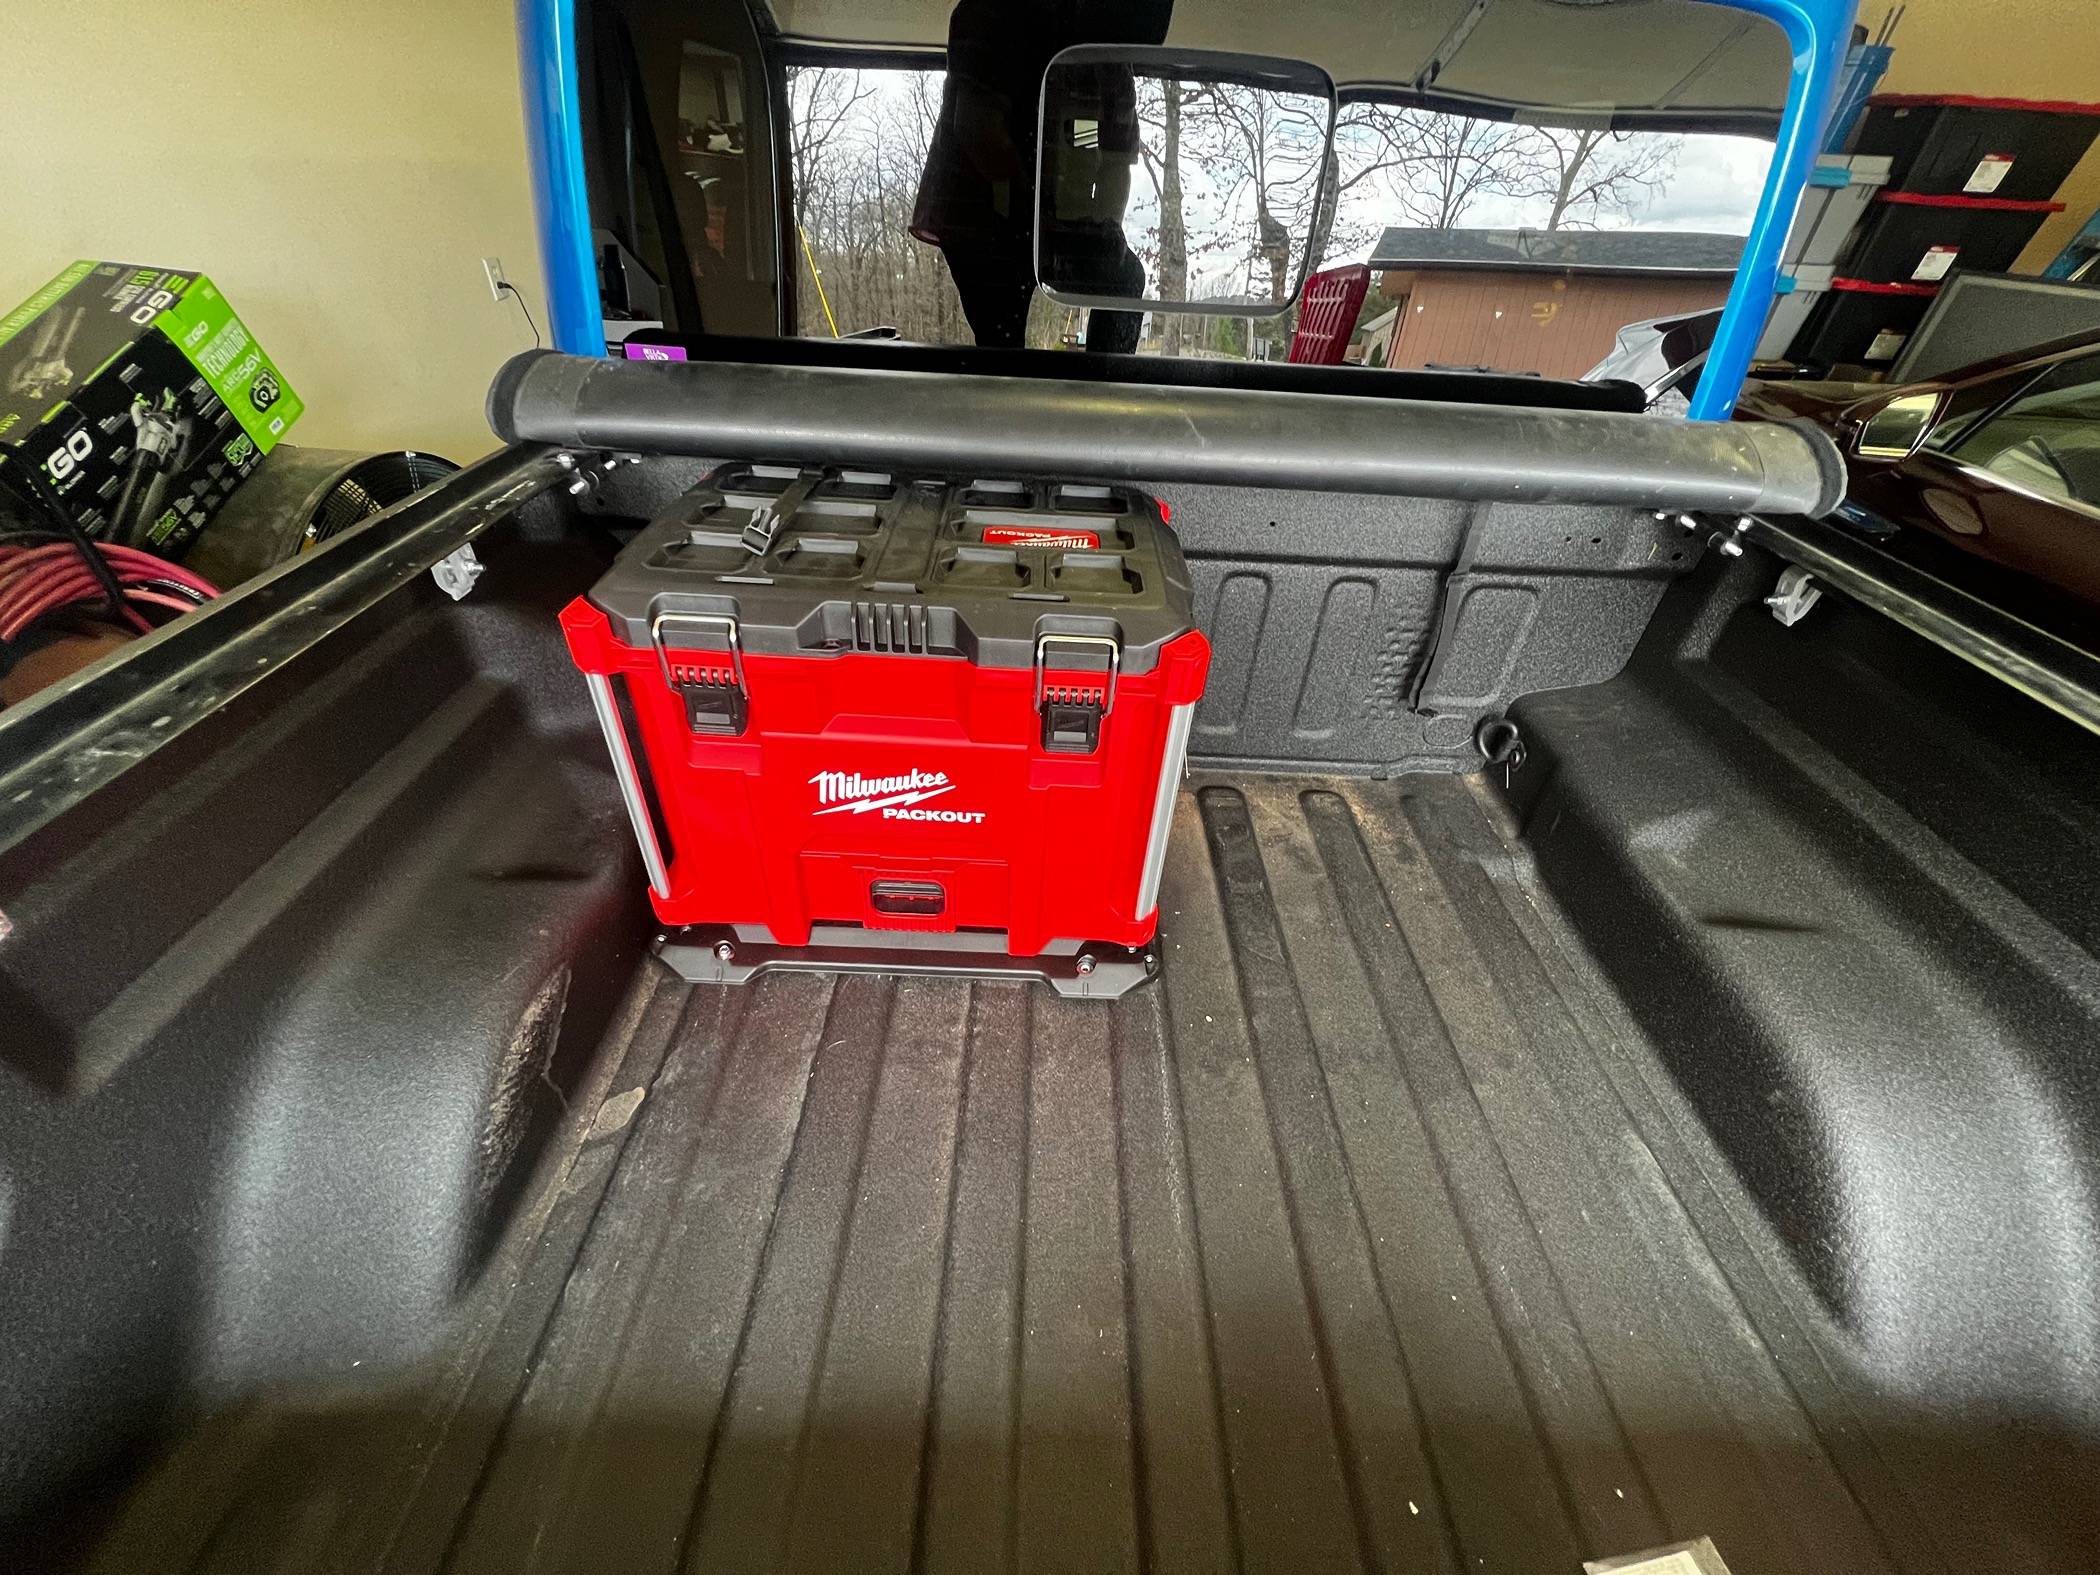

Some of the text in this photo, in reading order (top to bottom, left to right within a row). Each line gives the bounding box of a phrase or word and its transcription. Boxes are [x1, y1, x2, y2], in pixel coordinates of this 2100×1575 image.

[202, 325, 250, 379] TECHNOLOGY
[41, 429, 94, 485] GO
[989, 530, 1051, 538] PACKOUT
[808, 768, 949, 804] Milwaukee
[883, 808, 986, 823] PACKOUT
